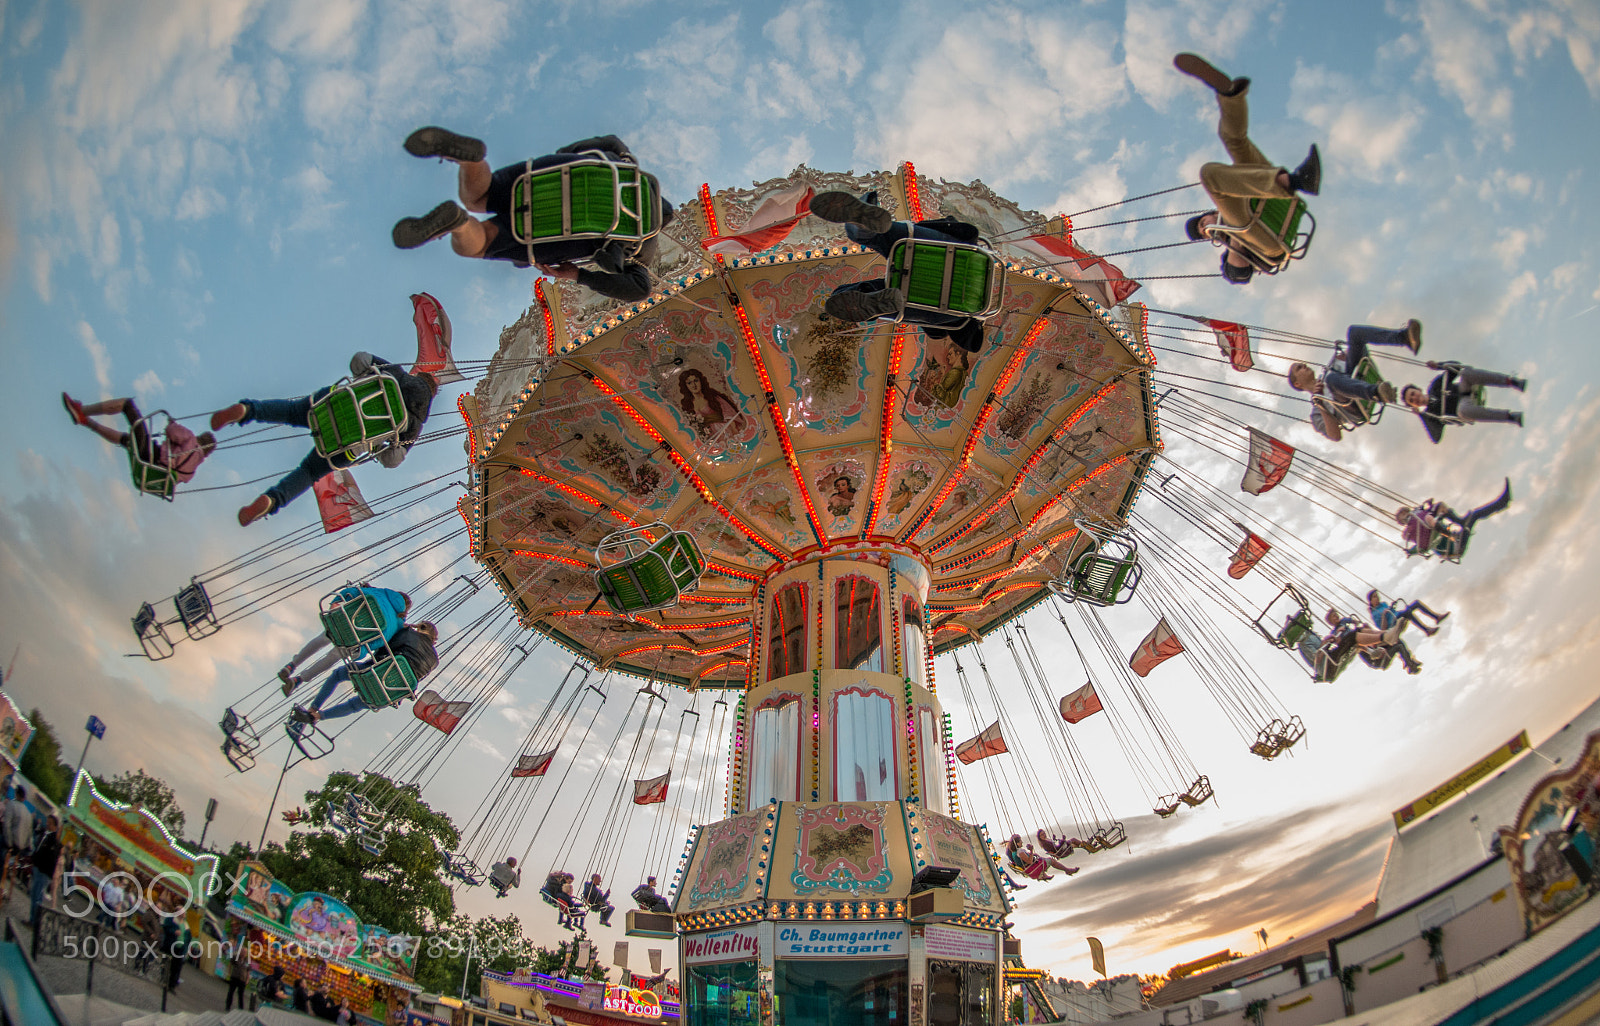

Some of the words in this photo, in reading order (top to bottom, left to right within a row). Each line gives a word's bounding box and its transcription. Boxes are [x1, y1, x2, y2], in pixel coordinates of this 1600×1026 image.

[779, 928, 803, 941] Ch.
[808, 928, 903, 945] Baumgartner
[685, 932, 759, 957] Wellenflug
[790, 943, 892, 955] Stuttgart
[627, 1003, 661, 1016] FOOD
